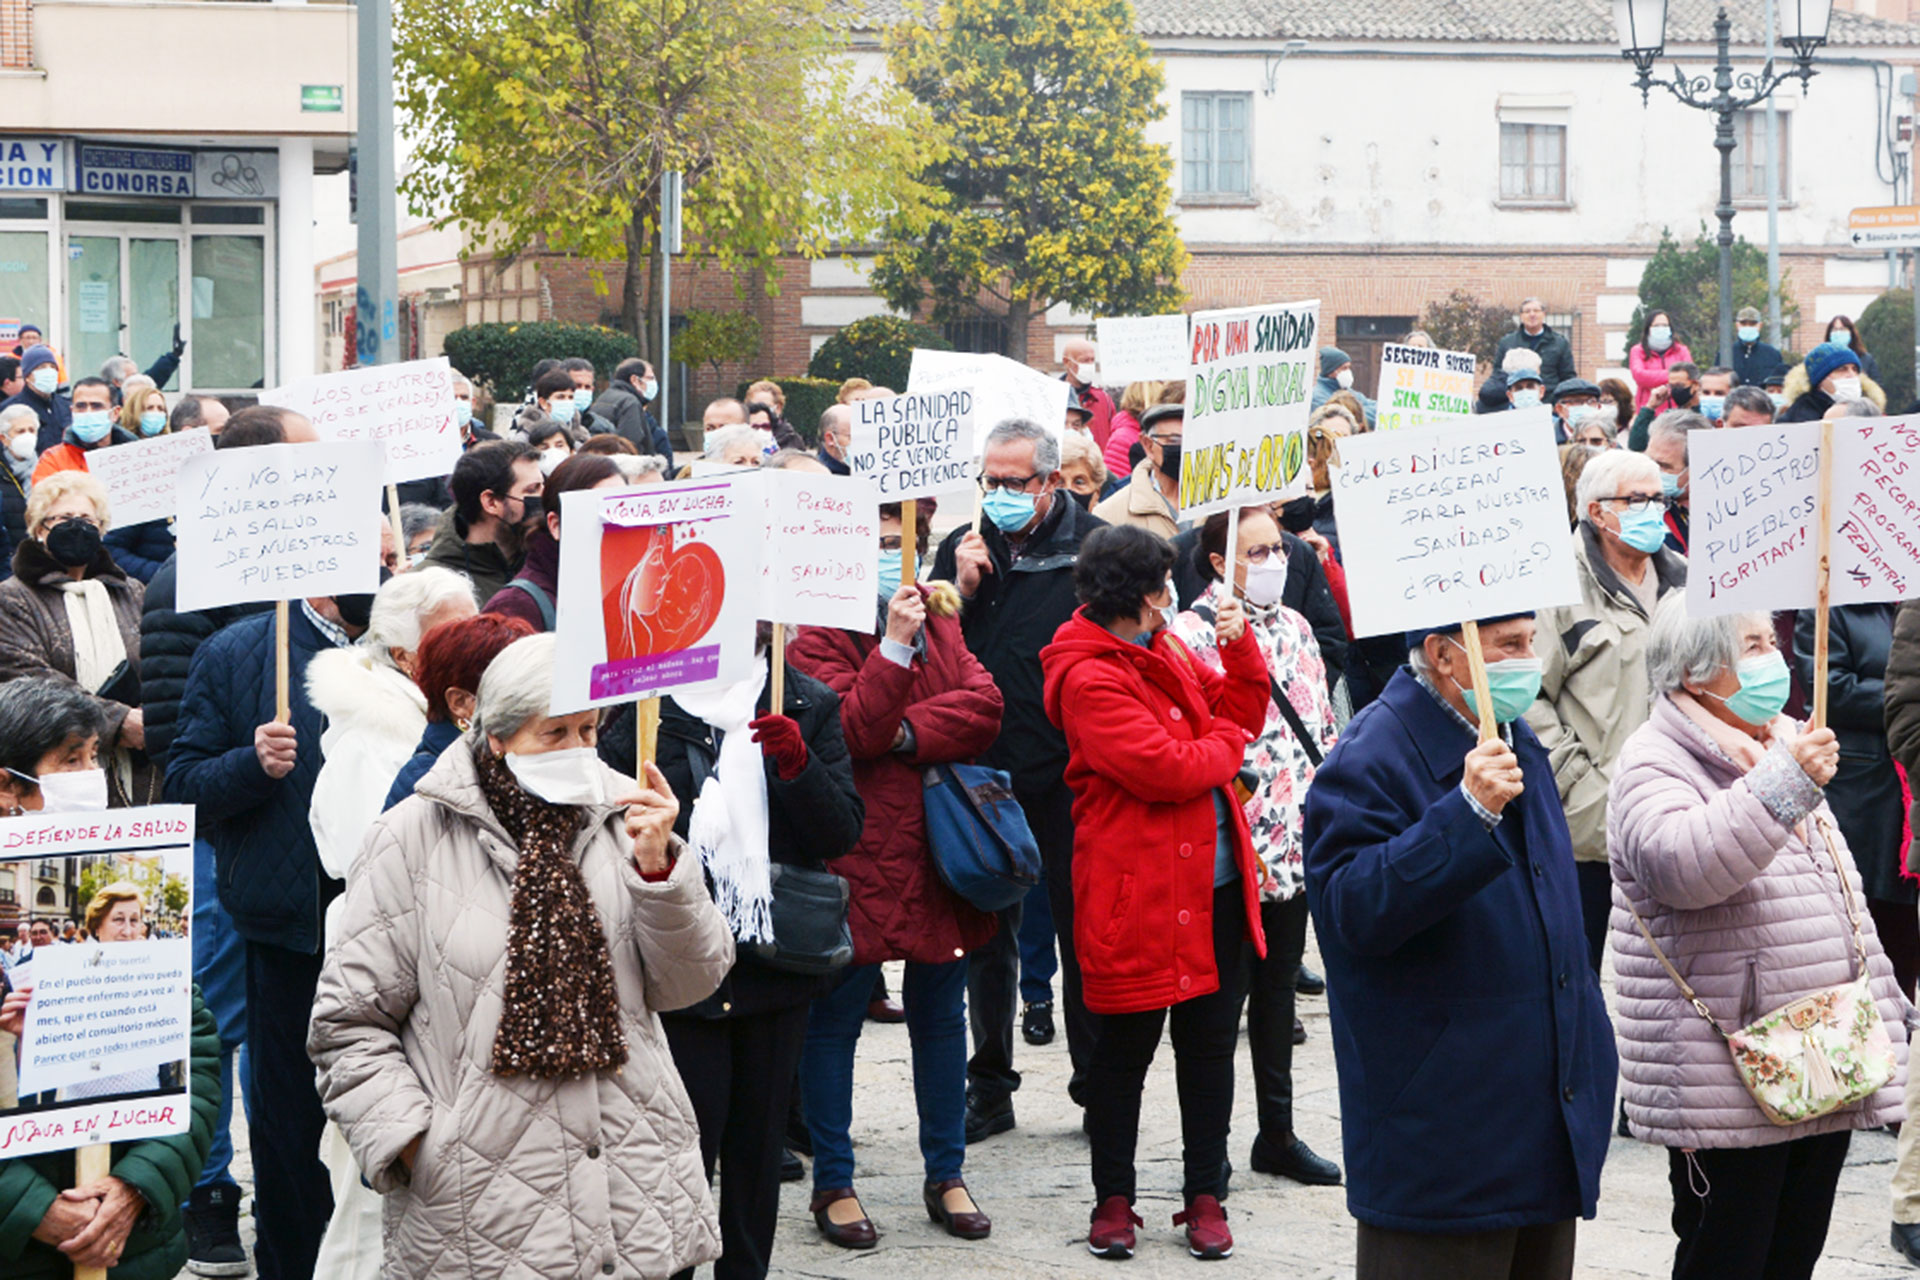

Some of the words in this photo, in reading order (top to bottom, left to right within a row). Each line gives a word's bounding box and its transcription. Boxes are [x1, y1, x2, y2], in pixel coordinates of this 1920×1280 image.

[40, 143, 57, 161] Y
[0, 167, 52, 186] ION
[87, 171, 190, 194] CONORSA
[1191, 323, 1220, 365] POR
[1225, 320, 1248, 357] UNA
[312, 386, 352, 405] LOS
[361, 370, 446, 396] CENTROS
[1253, 362, 1306, 408] RURAL
[1392, 388, 1421, 409] SIN
[312, 410, 337, 424] NO
[344, 405, 368, 417] SE
[861, 401, 885, 424] LA
[893, 391, 971, 423] SANIDAD
[879, 418, 958, 449] PUBLICA
[854, 452, 875, 472] NO
[882, 449, 901, 470] SE
[907, 444, 952, 466] VENDE
[1699, 434, 1789, 490] TODOS
[1857, 426, 1874, 440] A
[1873, 441, 1909, 475] LOS
[249, 466, 280, 489] NO
[293, 465, 338, 484] HAY
[899, 461, 969, 490] DEFIENDE
[1180, 440, 1235, 510] NAVAS
[1236, 447, 1255, 489] DE
[1256, 430, 1303, 492] ORO
[1387, 466, 1504, 504] ESCASEAN
[658, 498, 680, 514] EN
[1400, 504, 1466, 525] PARA
[1476, 486, 1551, 512] NUESTRA
[212, 526, 238, 542] LA
[248, 515, 318, 535] SALUD
[1705, 495, 1815, 564] PUEBLOS
[1854, 492, 1920, 565] PROGRAM
[216, 547, 249, 568] DE
[257, 532, 359, 559] NUESTROS
[239, 557, 338, 585] PUEBLOS
[1846, 564, 1872, 589] YA
[104, 824, 122, 841] LA
[128, 820, 187, 838] SALUD
[39, 979, 52, 990] En
[54, 978, 64, 989] el
[66, 976, 102, 989] pueblo
[104, 973, 134, 984] donde
[137, 972, 155, 981] vivo
[37, 994, 85, 1010] ponerme
[87, 990, 130, 1003] enfermo
[132, 988, 148, 998] una
[150, 986, 166, 996] vez
[167, 984, 175, 994] al
[64, 1012, 84, 1025] que
[87, 1012, 98, 1021] es
[100, 1005, 136, 1019] cuando
[35, 1031, 74, 1046] abierto
[76, 1029, 86, 1040] el
[88, 1021, 143, 1038] consultorio
[33, 1052, 67, 1065] Parece
[69, 1049, 86, 1060] que
[88, 1046, 102, 1056] no
[103, 1042, 128, 1053] todos
[73, 1115, 100, 1134] EN
[108, 1107, 176, 1129] LUCHA
